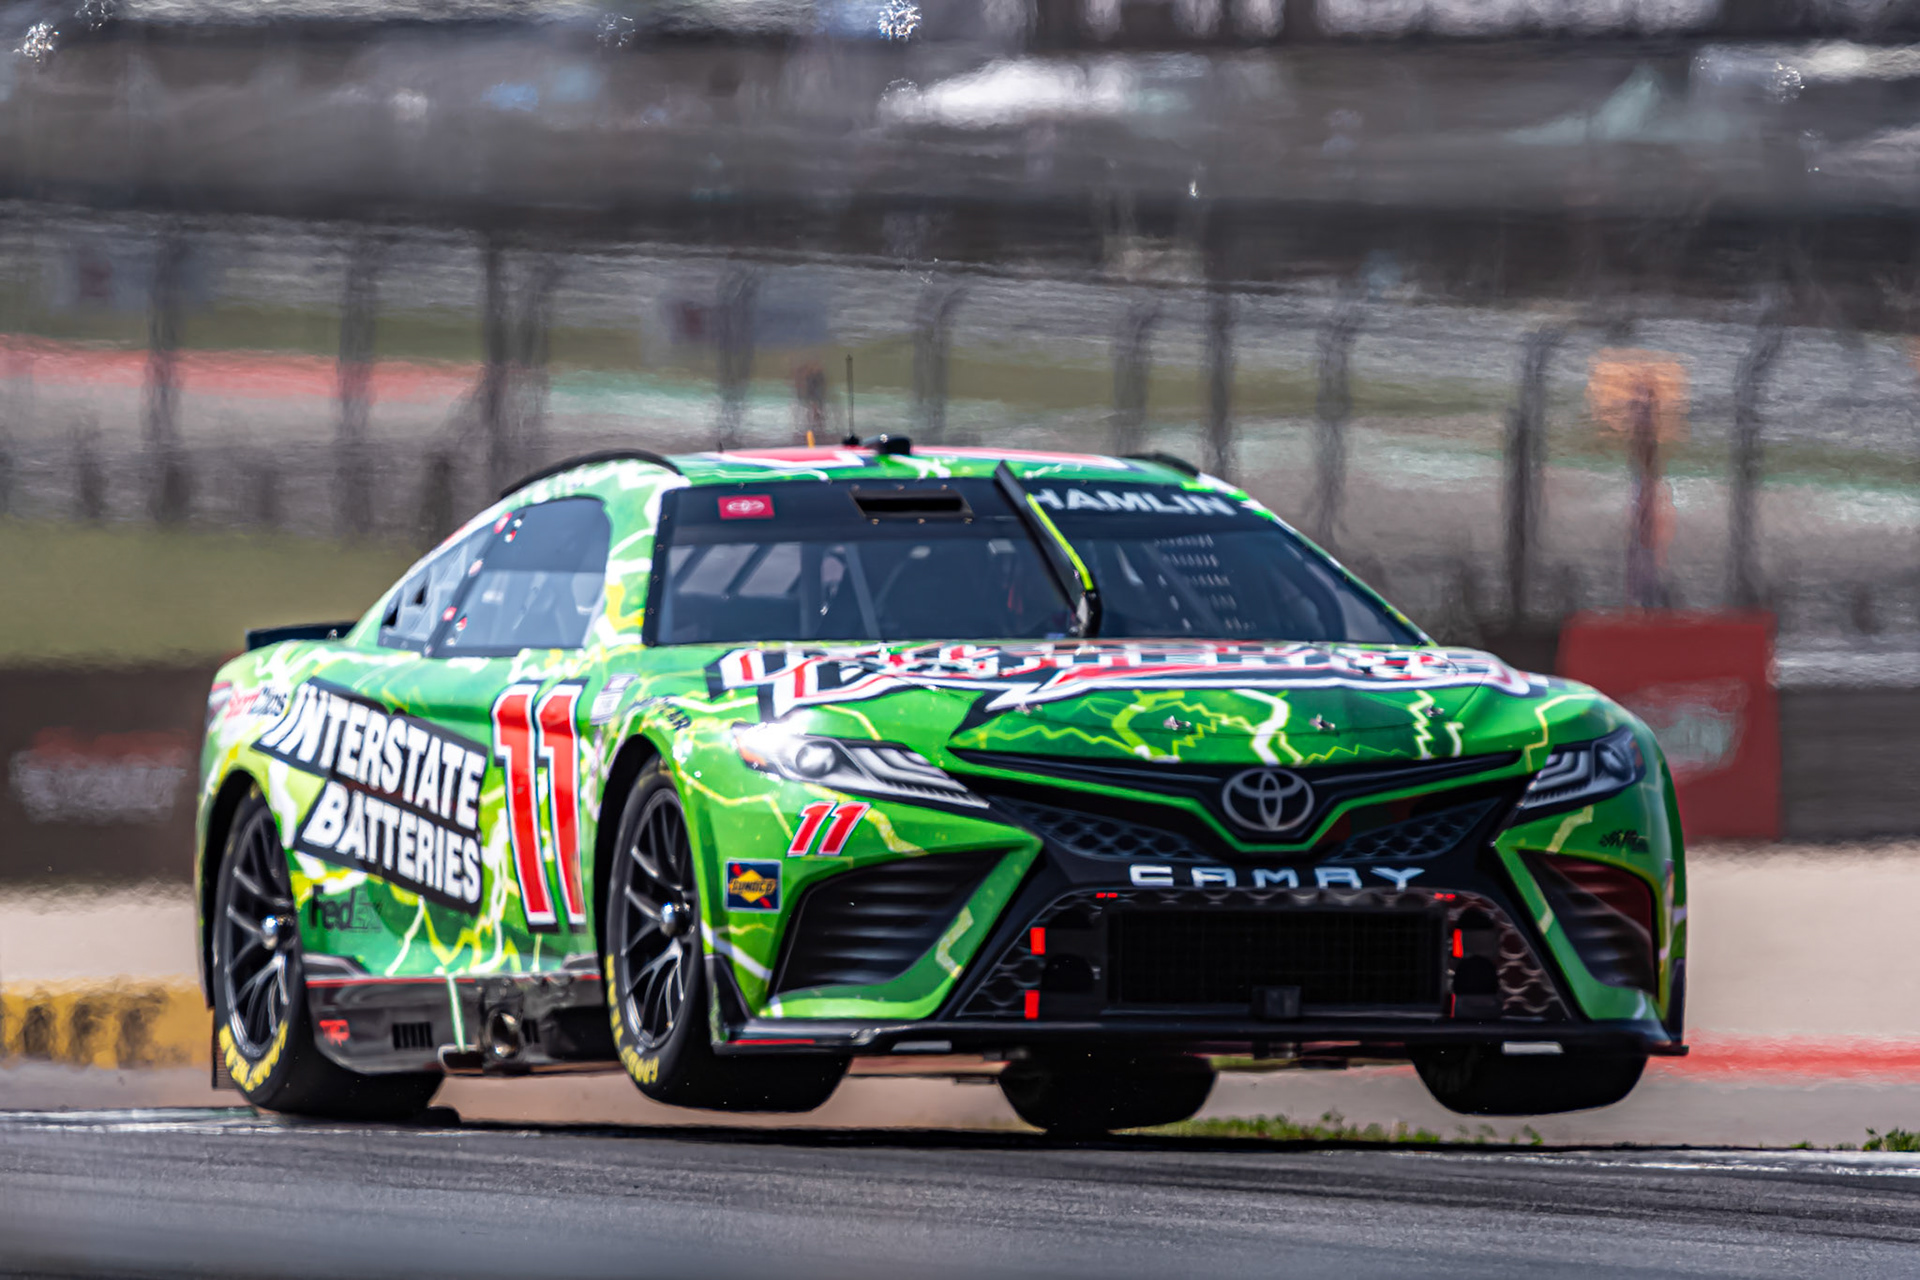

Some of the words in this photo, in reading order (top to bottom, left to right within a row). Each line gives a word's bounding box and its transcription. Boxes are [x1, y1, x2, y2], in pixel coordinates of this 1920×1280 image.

[1033, 488, 1237, 516] HAMLIN
[259, 683, 487, 831] INTERSTATE
[301, 780, 482, 905] BATTERIES
[491, 680, 587, 928] 11
[786, 801, 871, 858] 11
[1128, 864, 1425, 891] CAMRY
